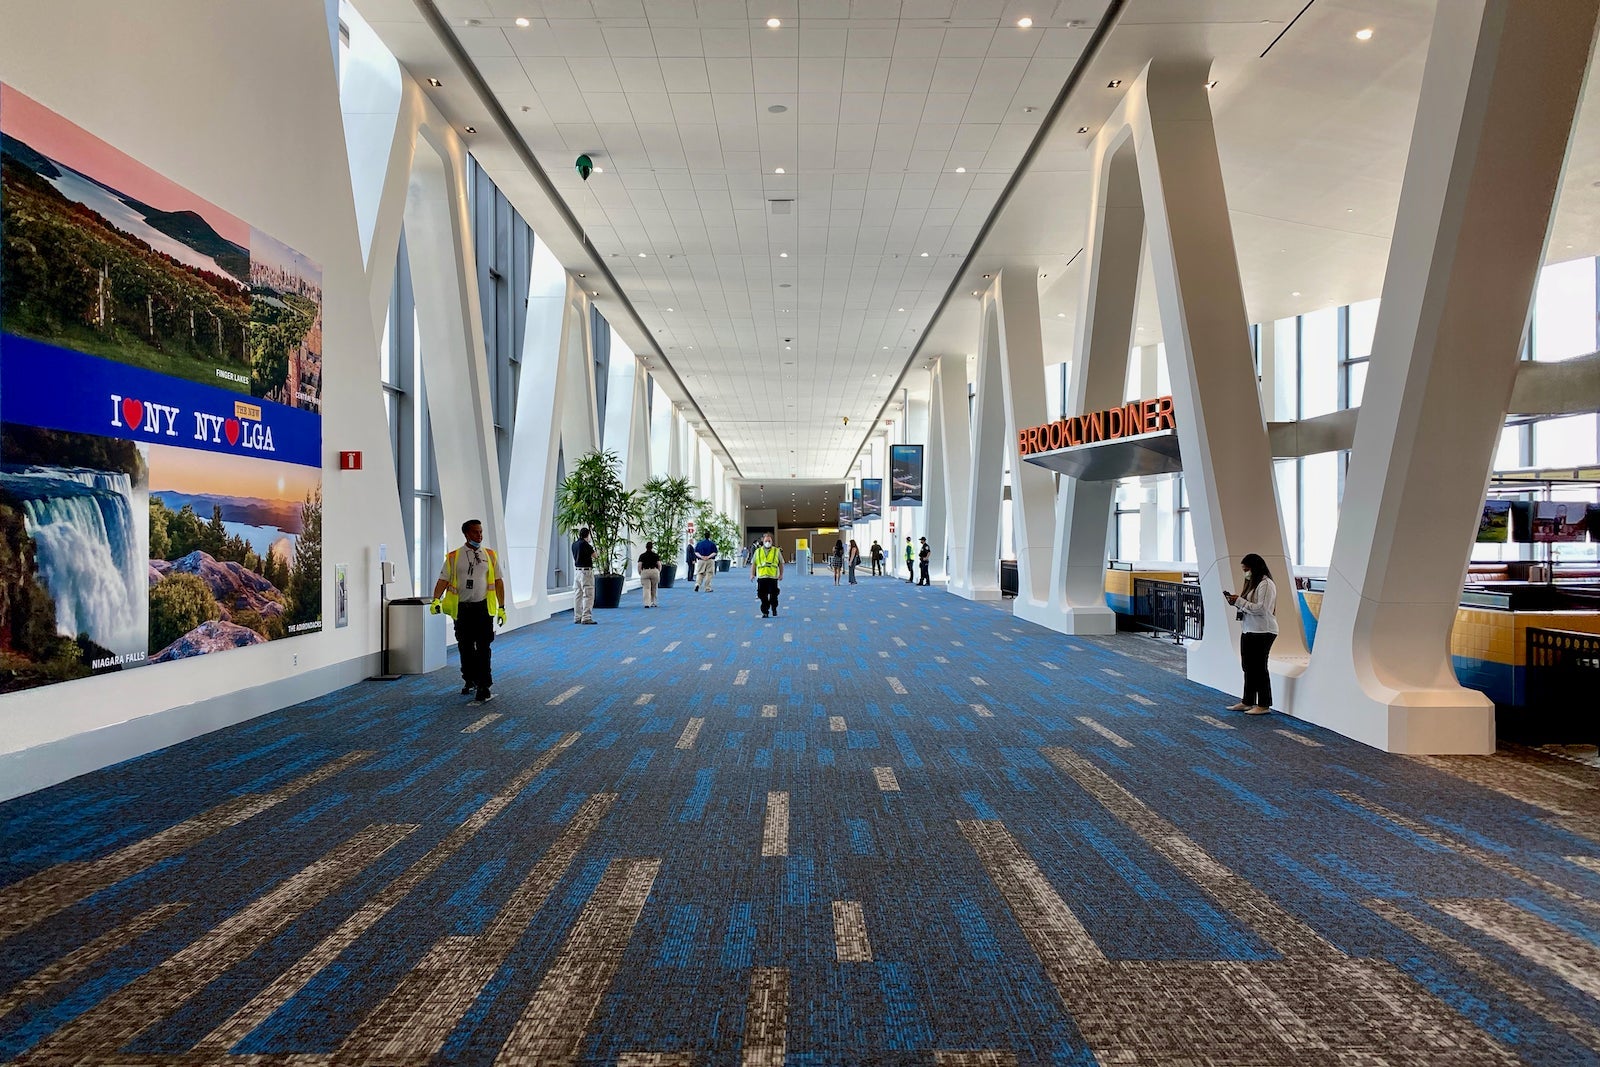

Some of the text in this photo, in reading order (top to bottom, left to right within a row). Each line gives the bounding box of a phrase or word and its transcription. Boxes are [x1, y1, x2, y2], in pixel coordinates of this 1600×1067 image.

[216, 368, 233, 381] FINGER
[111, 394, 122, 427] I
[236, 404, 260, 418] THE NEW
[194, 411, 275, 451] NY LGA
[1018, 395, 1176, 456] BROOKLYN DINER
[92, 651, 145, 669] NIAGARA FALLS
